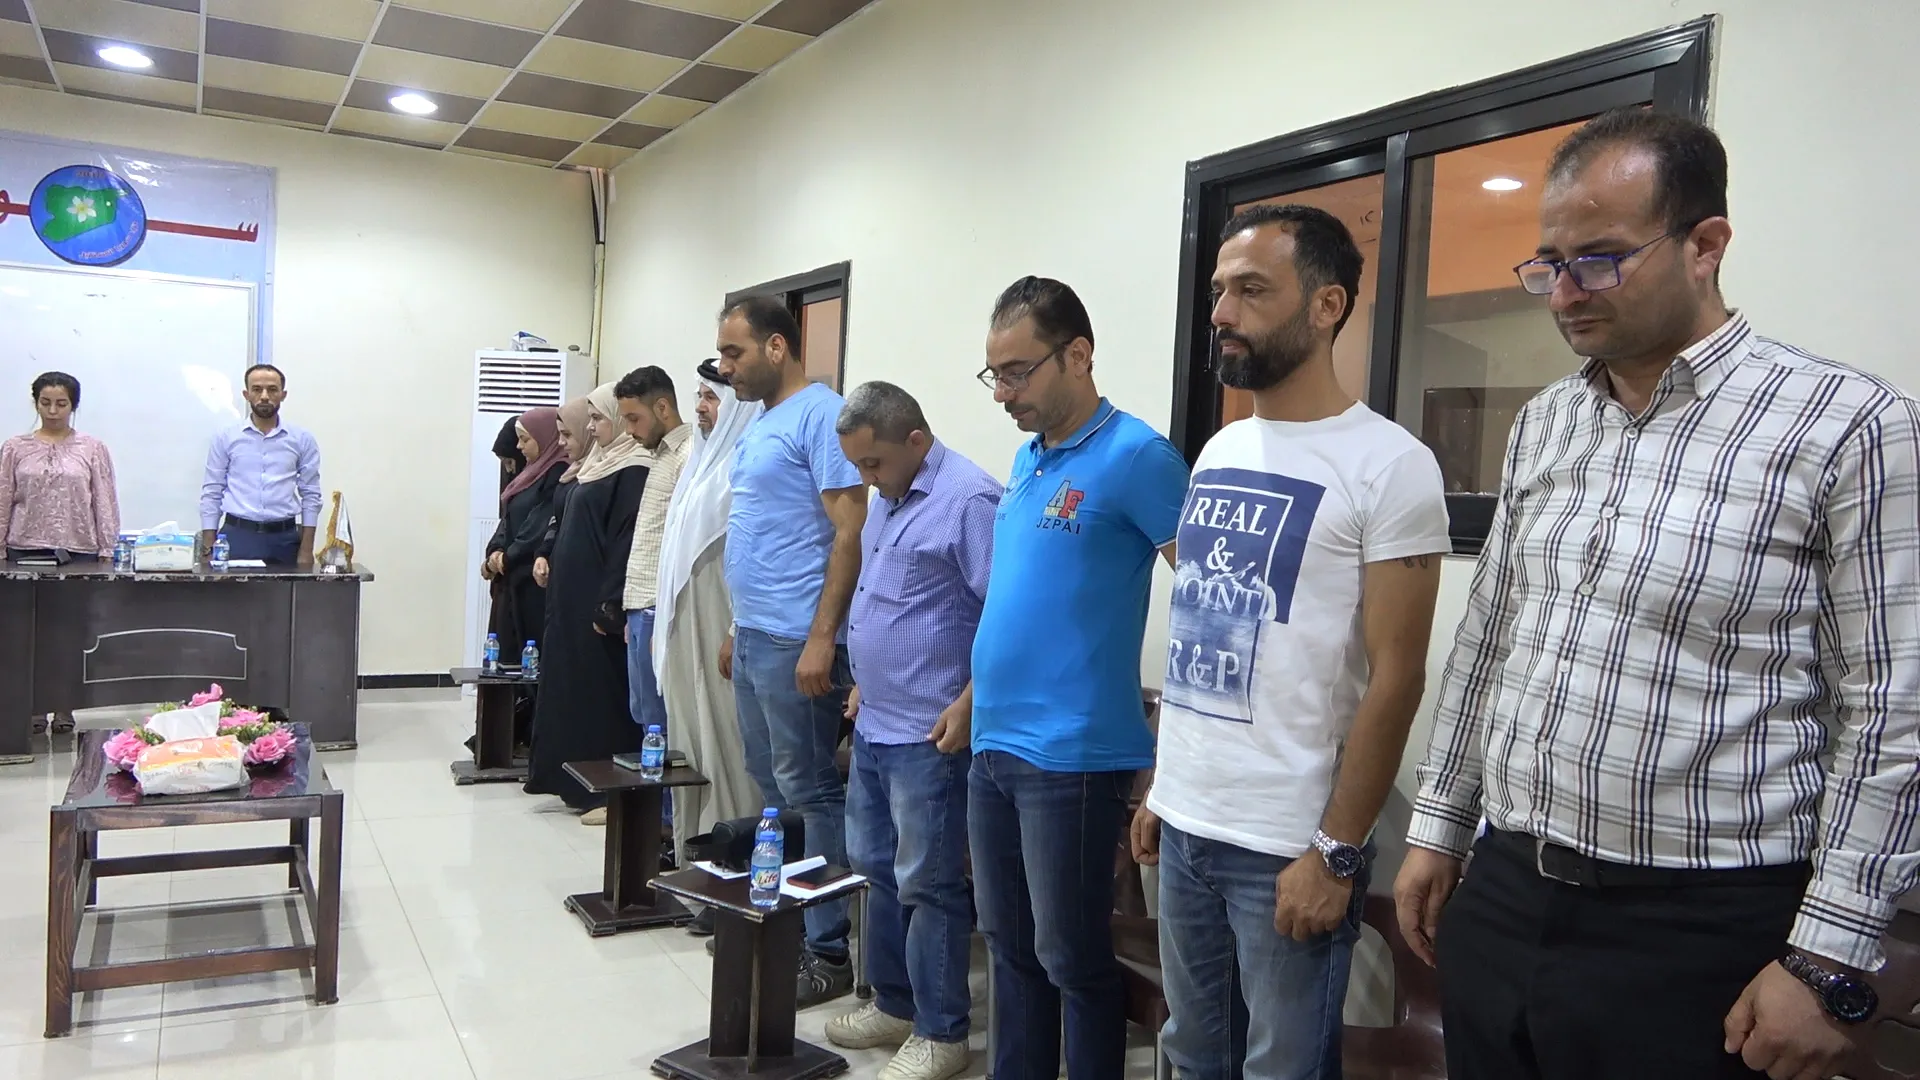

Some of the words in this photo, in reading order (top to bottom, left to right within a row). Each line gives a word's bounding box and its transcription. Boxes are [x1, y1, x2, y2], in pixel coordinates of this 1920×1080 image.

[1187, 497, 1268, 536] REAL
[1206, 536, 1234, 572] &
[758, 872, 777, 885] Life
